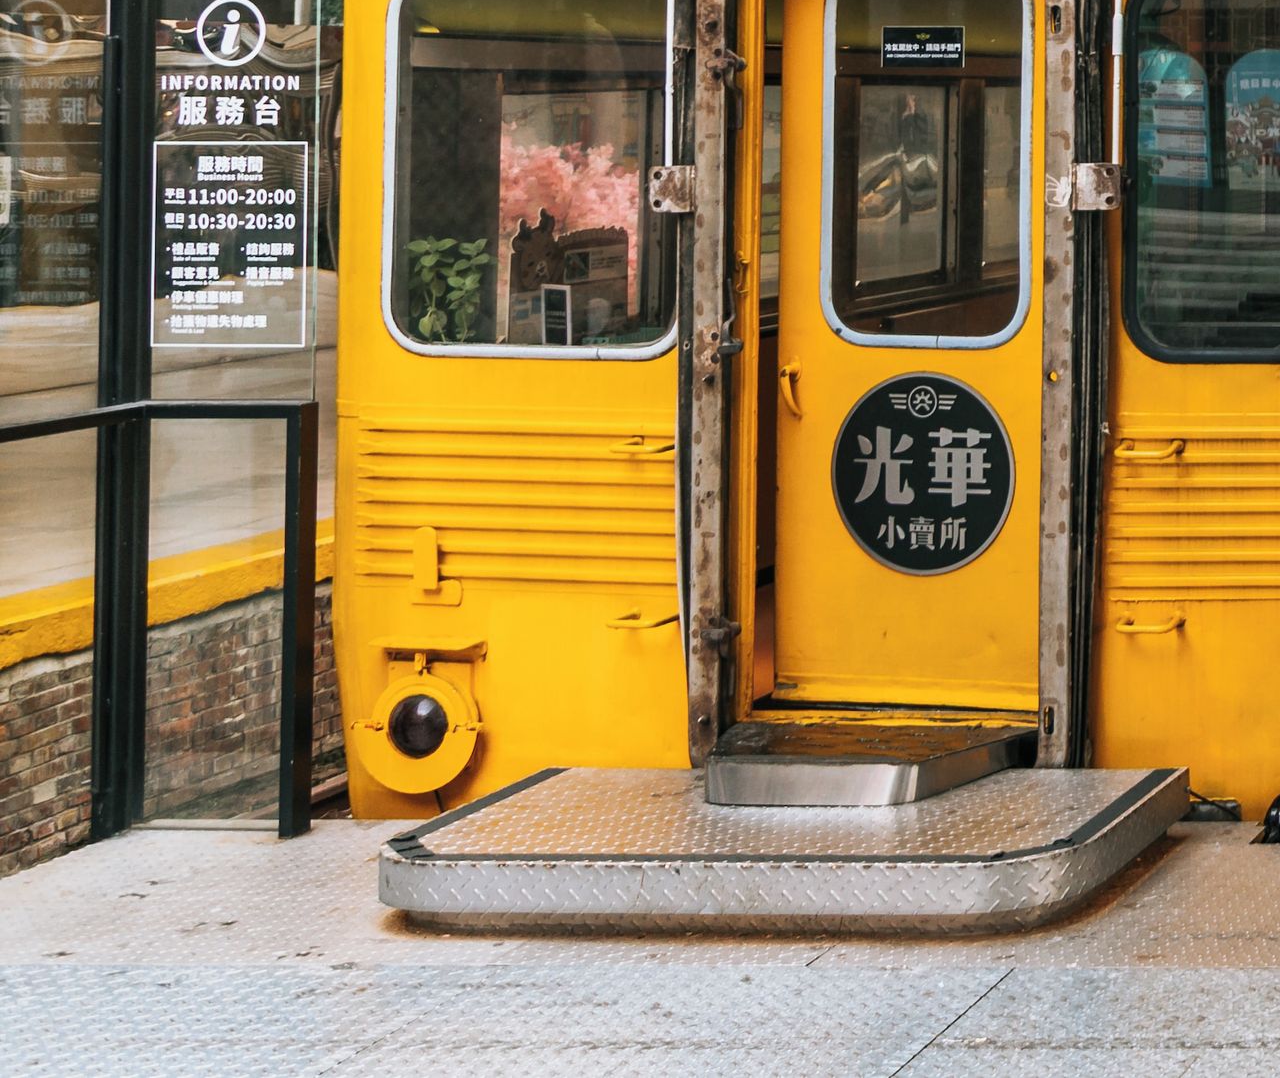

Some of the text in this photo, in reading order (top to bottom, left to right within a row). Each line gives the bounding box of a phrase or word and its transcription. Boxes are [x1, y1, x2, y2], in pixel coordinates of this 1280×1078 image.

[161, 74, 300, 91] INFORMATION
[178, 95, 281, 126] 服務台
[197, 155, 264, 173] 服務時間
[197, 173, 264, 182] Business Hours
[187, 188, 297, 206] 11:00-20:00
[187, 212, 296, 231] 10:30-20:30
[855, 425, 992, 507] 光華
[877, 515, 967, 551] 小賣所
